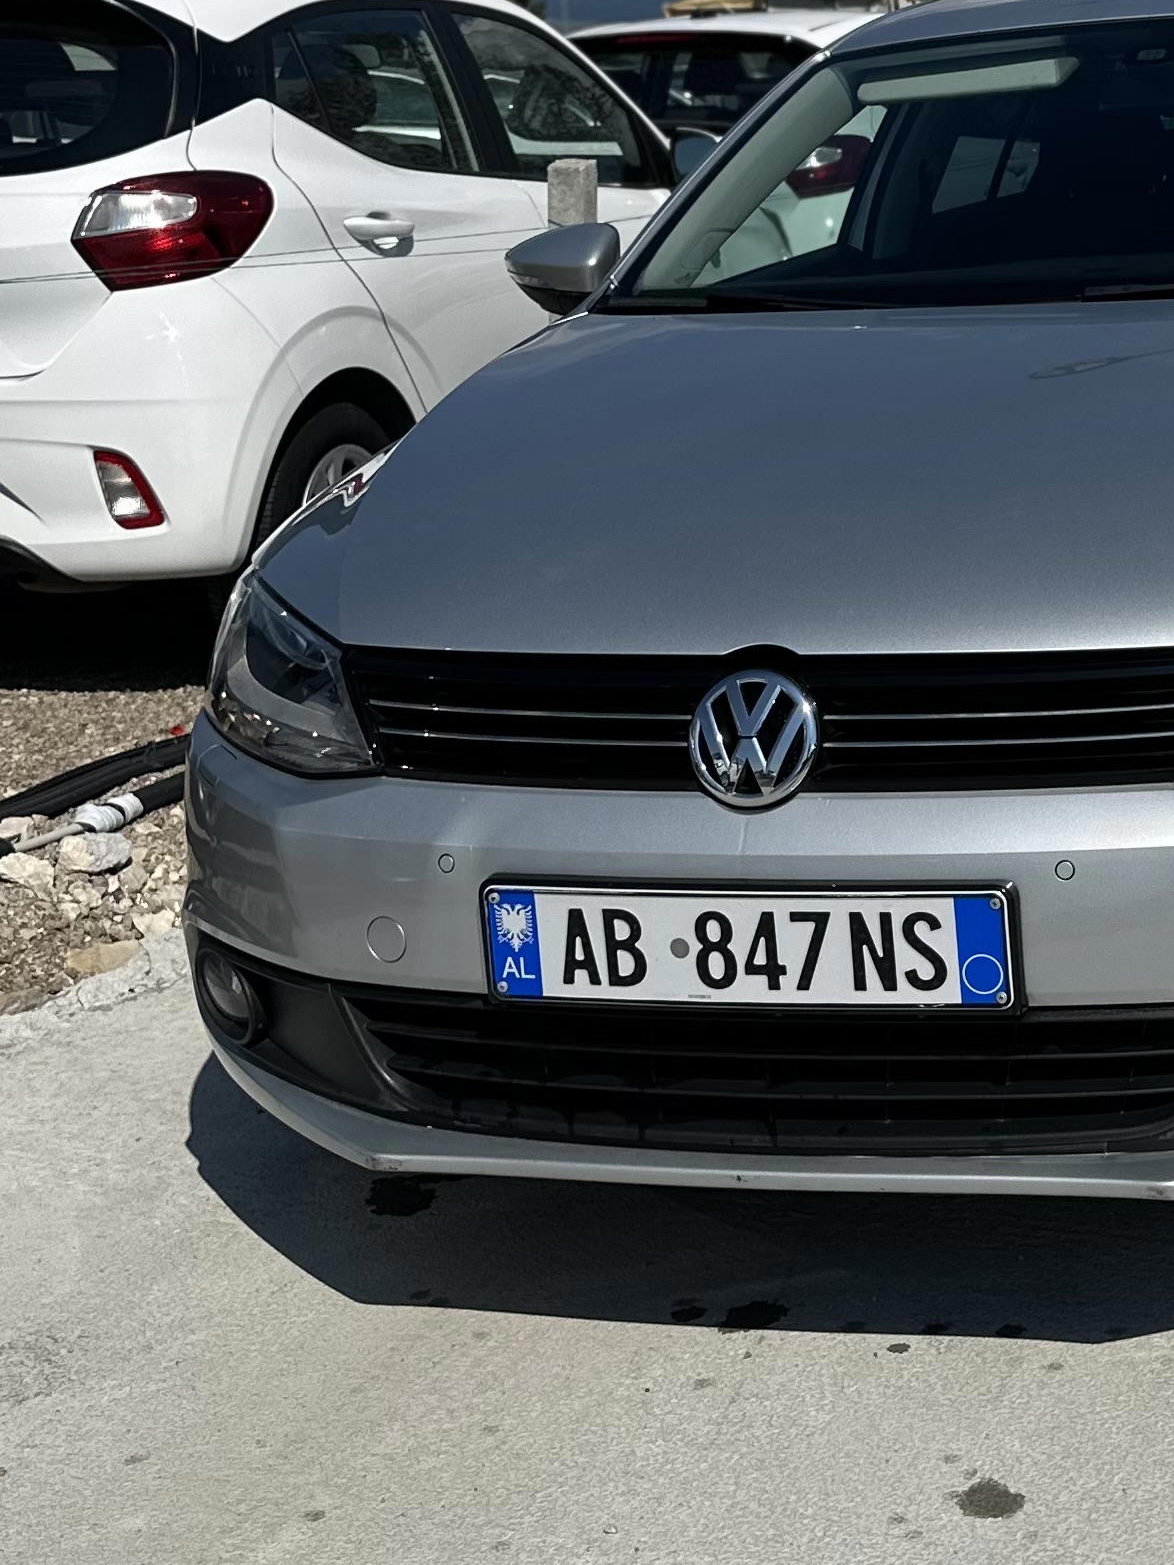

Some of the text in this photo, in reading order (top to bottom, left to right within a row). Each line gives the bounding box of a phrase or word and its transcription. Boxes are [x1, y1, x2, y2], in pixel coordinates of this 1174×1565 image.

[690, 669, 816, 807] VW
[503, 956, 536, 979] AL
[562, 908, 948, 992] AB 847 NS
